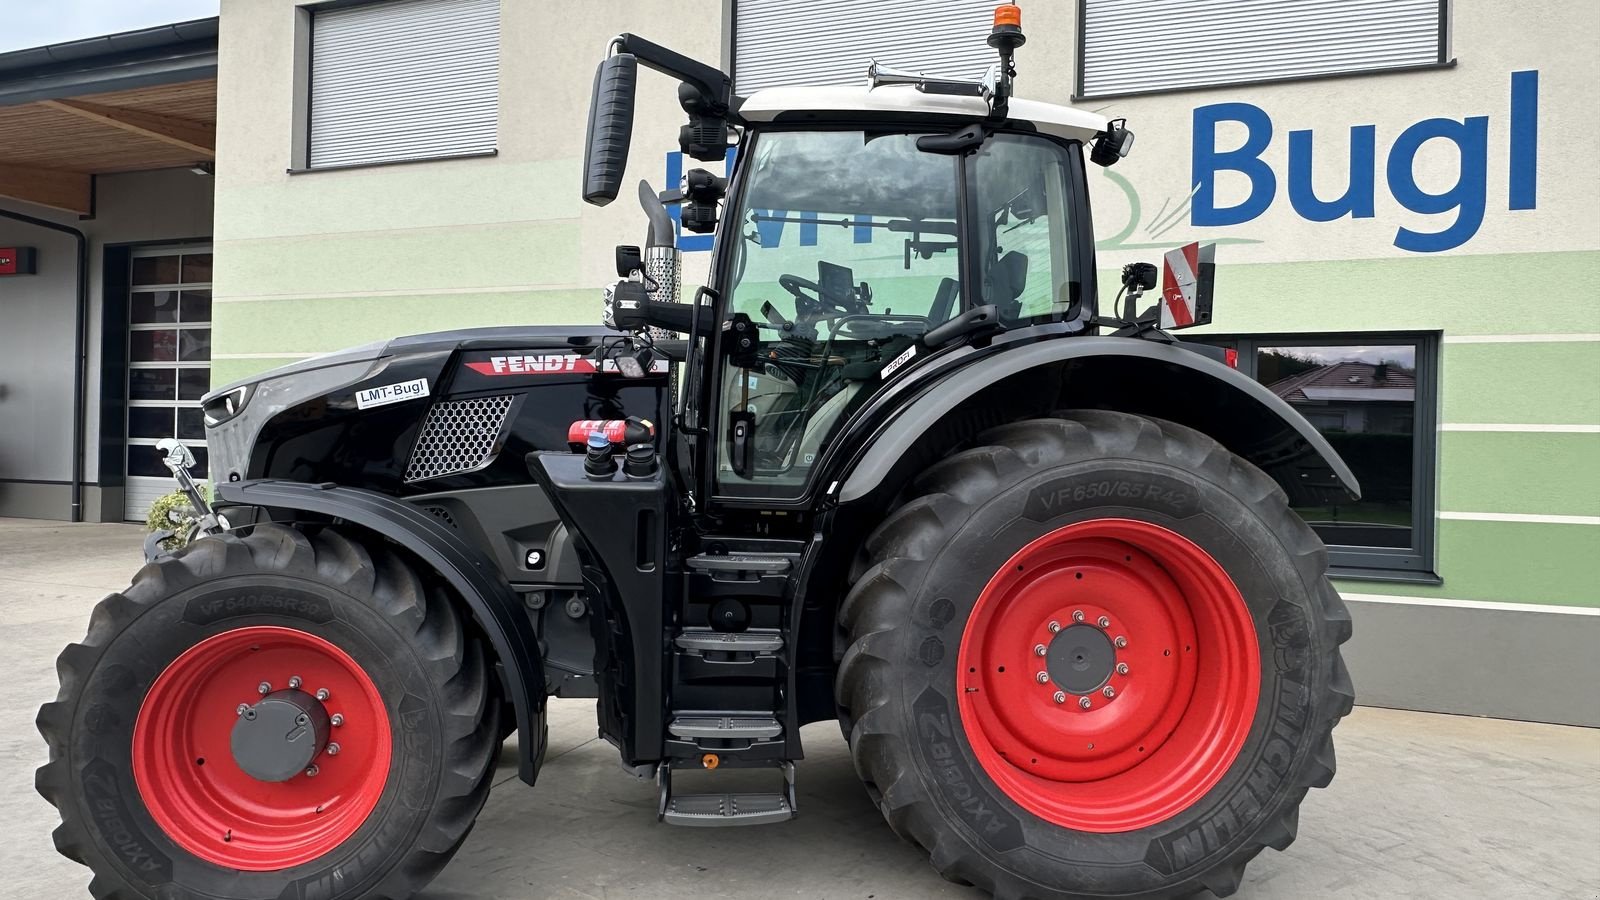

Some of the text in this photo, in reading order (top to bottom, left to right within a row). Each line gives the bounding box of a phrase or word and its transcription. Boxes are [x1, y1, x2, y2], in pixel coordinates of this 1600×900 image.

[1190, 69, 1539, 253] Bugl
[490, 354, 581, 373] FENDT
[887, 351, 910, 374] PROFI
[360, 380, 424, 403] LMT-Bugl
[1172, 680, 1309, 870] MICHELIN
